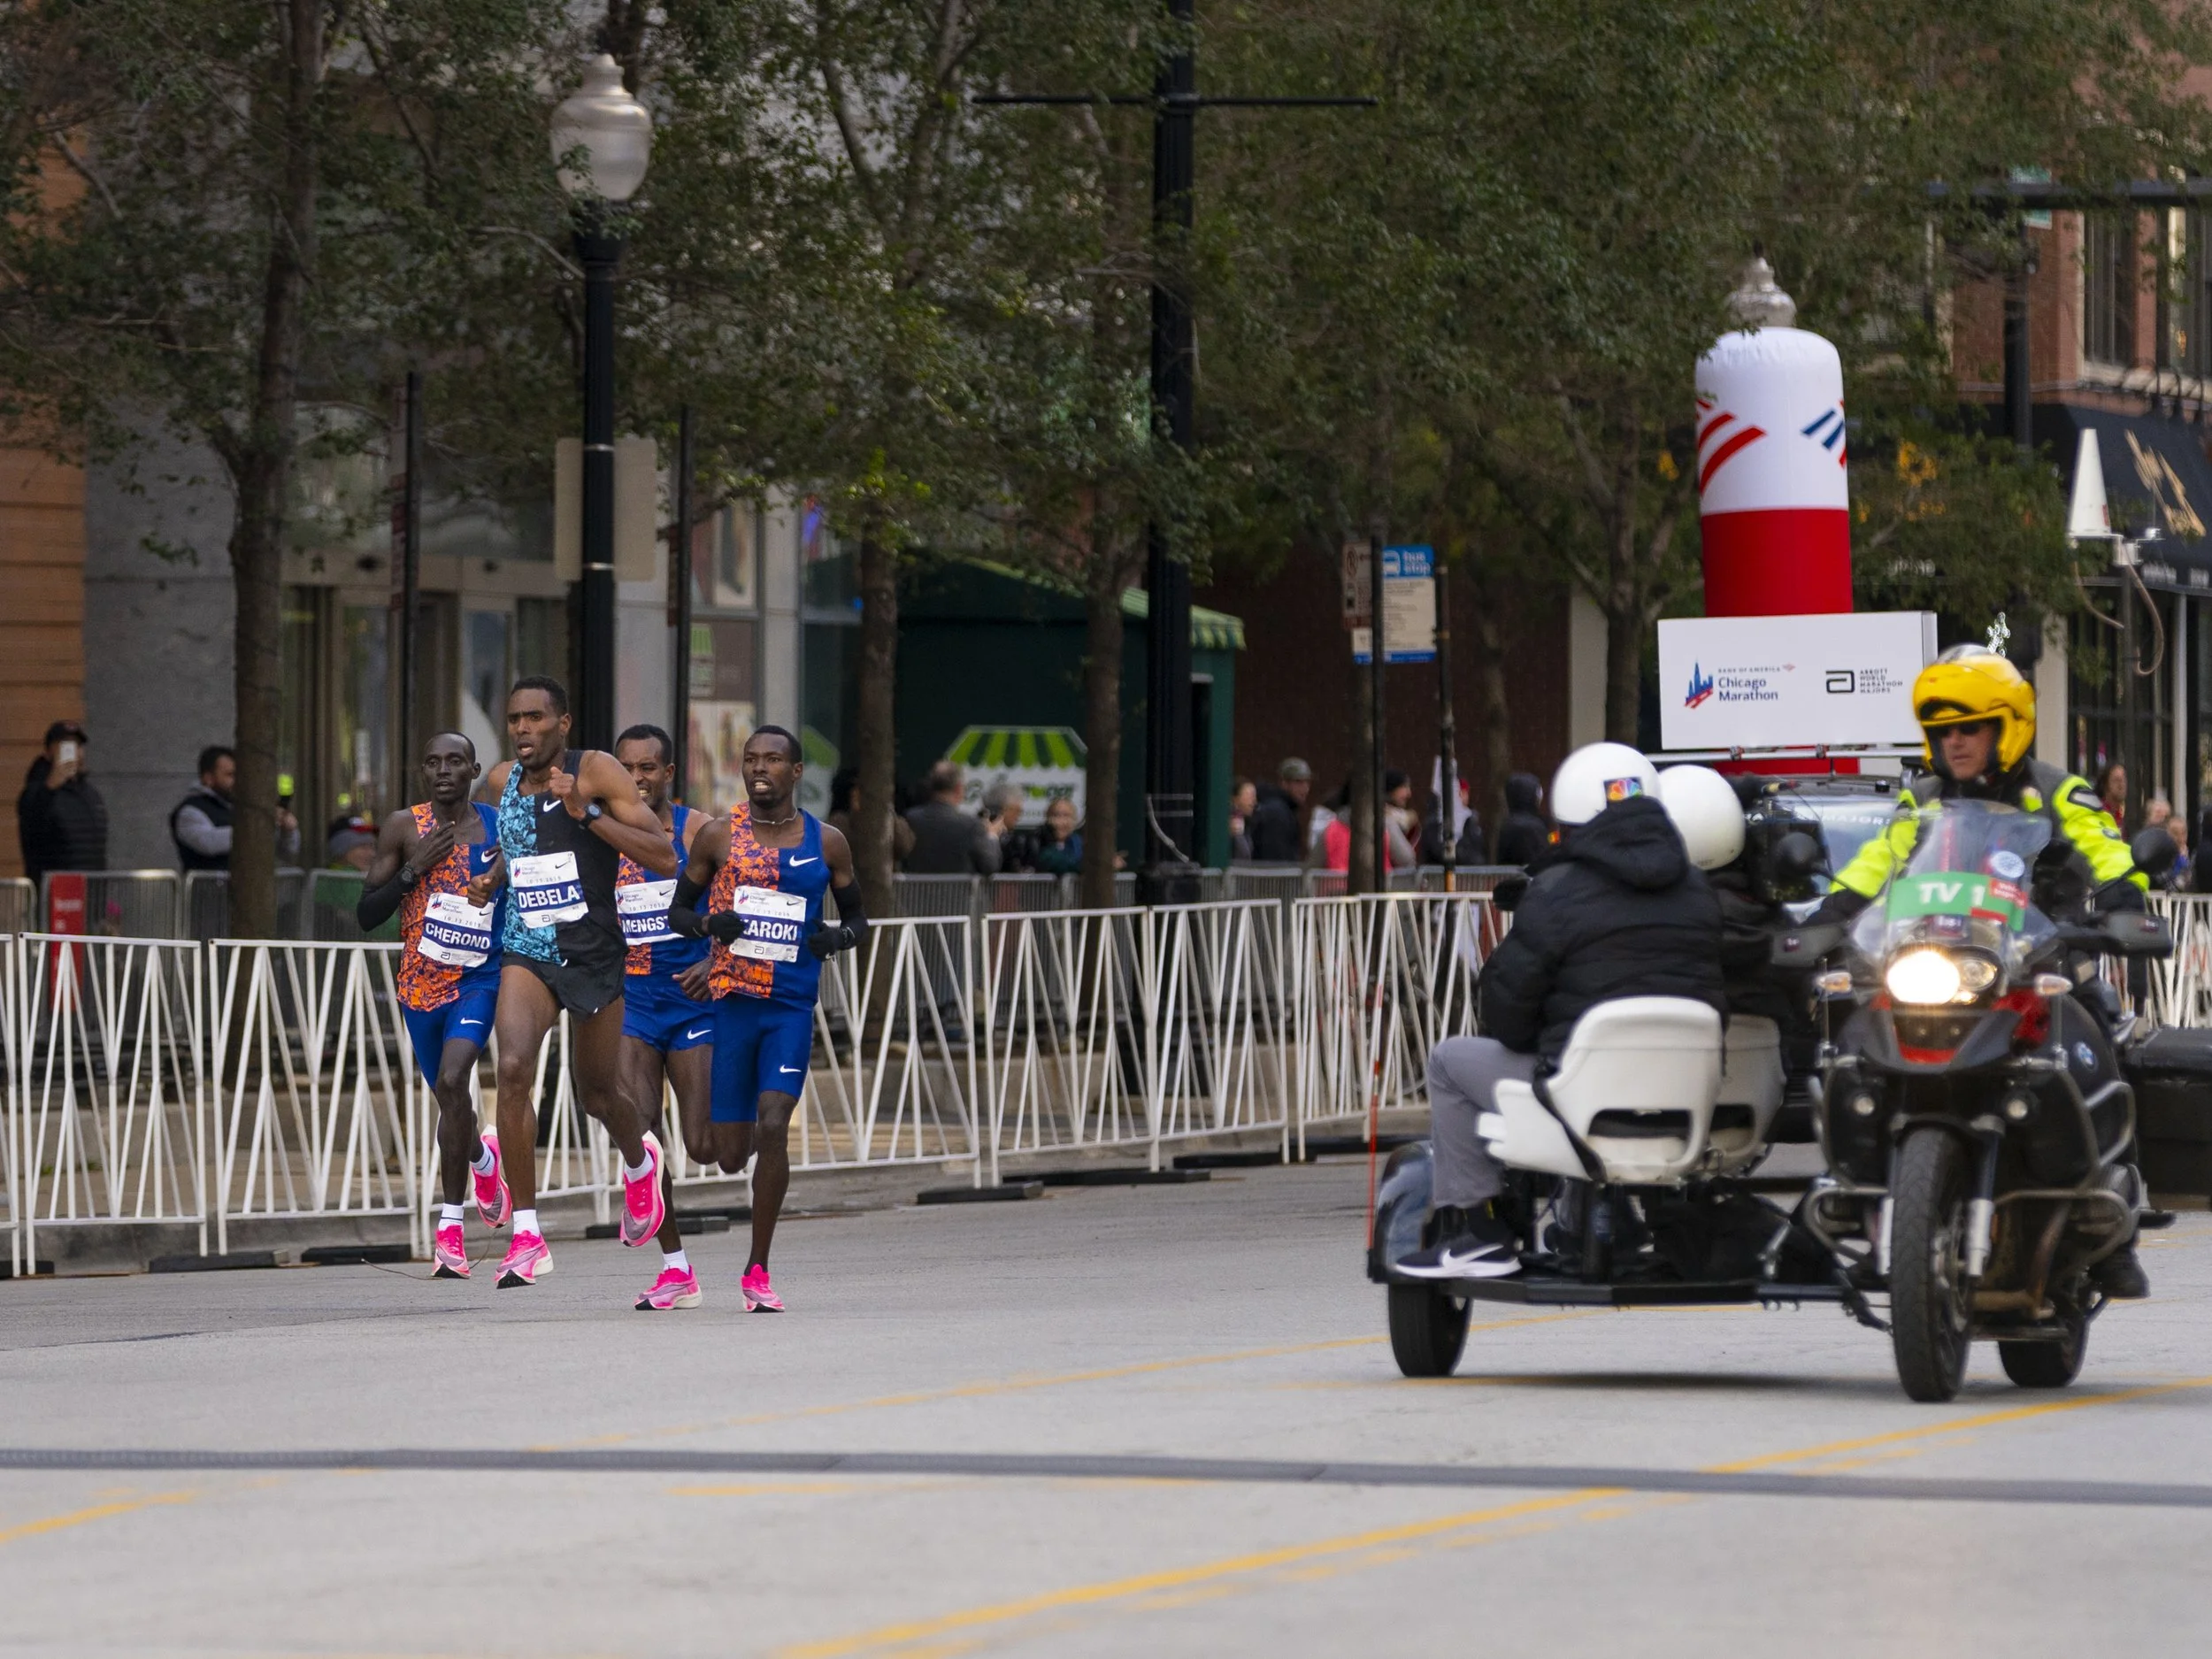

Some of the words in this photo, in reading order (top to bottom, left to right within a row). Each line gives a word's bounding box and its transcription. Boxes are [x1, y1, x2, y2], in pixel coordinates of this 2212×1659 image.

[1718, 676, 1767, 690] Chicago
[1719, 689, 1778, 702] Marathon
[518, 885, 580, 908] DEBELA
[1918, 882, 1962, 904] TV
[1971, 885, 1985, 907] 1
